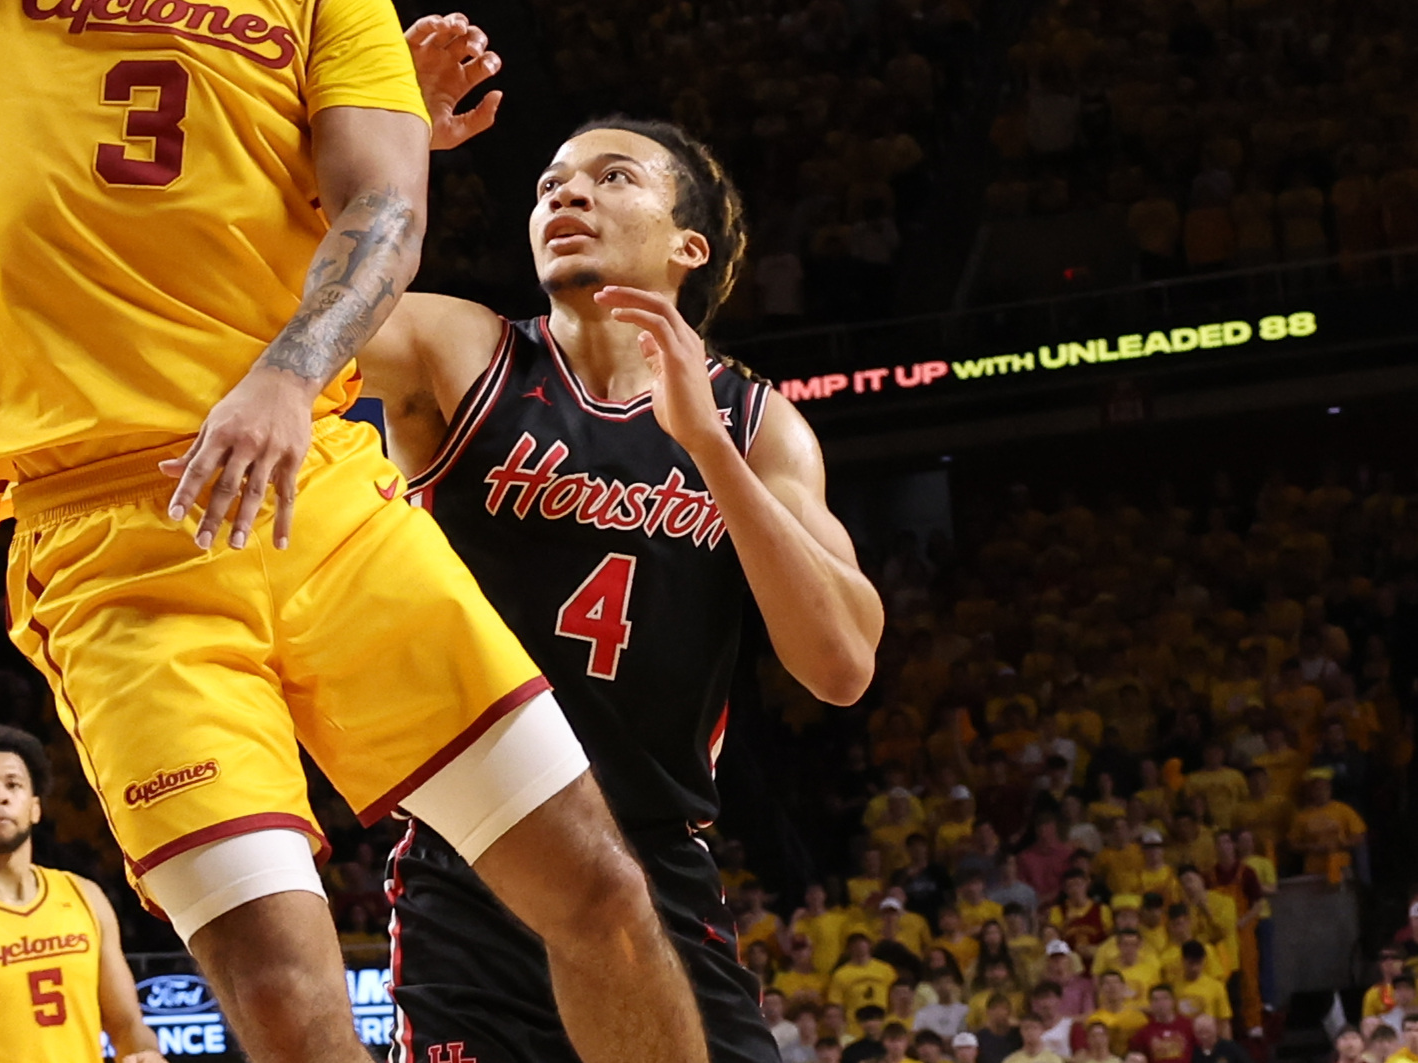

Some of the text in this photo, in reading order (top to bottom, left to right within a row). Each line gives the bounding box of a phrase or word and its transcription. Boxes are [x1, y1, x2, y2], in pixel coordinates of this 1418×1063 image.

[93, 59, 190, 191] 3
[853, 368, 889, 393] IT
[894, 360, 948, 388] UP
[952, 352, 1035, 379] WITH
[1038, 321, 1253, 369] UNLEADED
[1258, 311, 1317, 340] 88
[484, 431, 727, 551] Houston
[555, 552, 637, 681] 4
[124, 760, 219, 806] Cyclones
[27, 967, 68, 1027] 5
[157, 1025, 226, 1055] NCE
